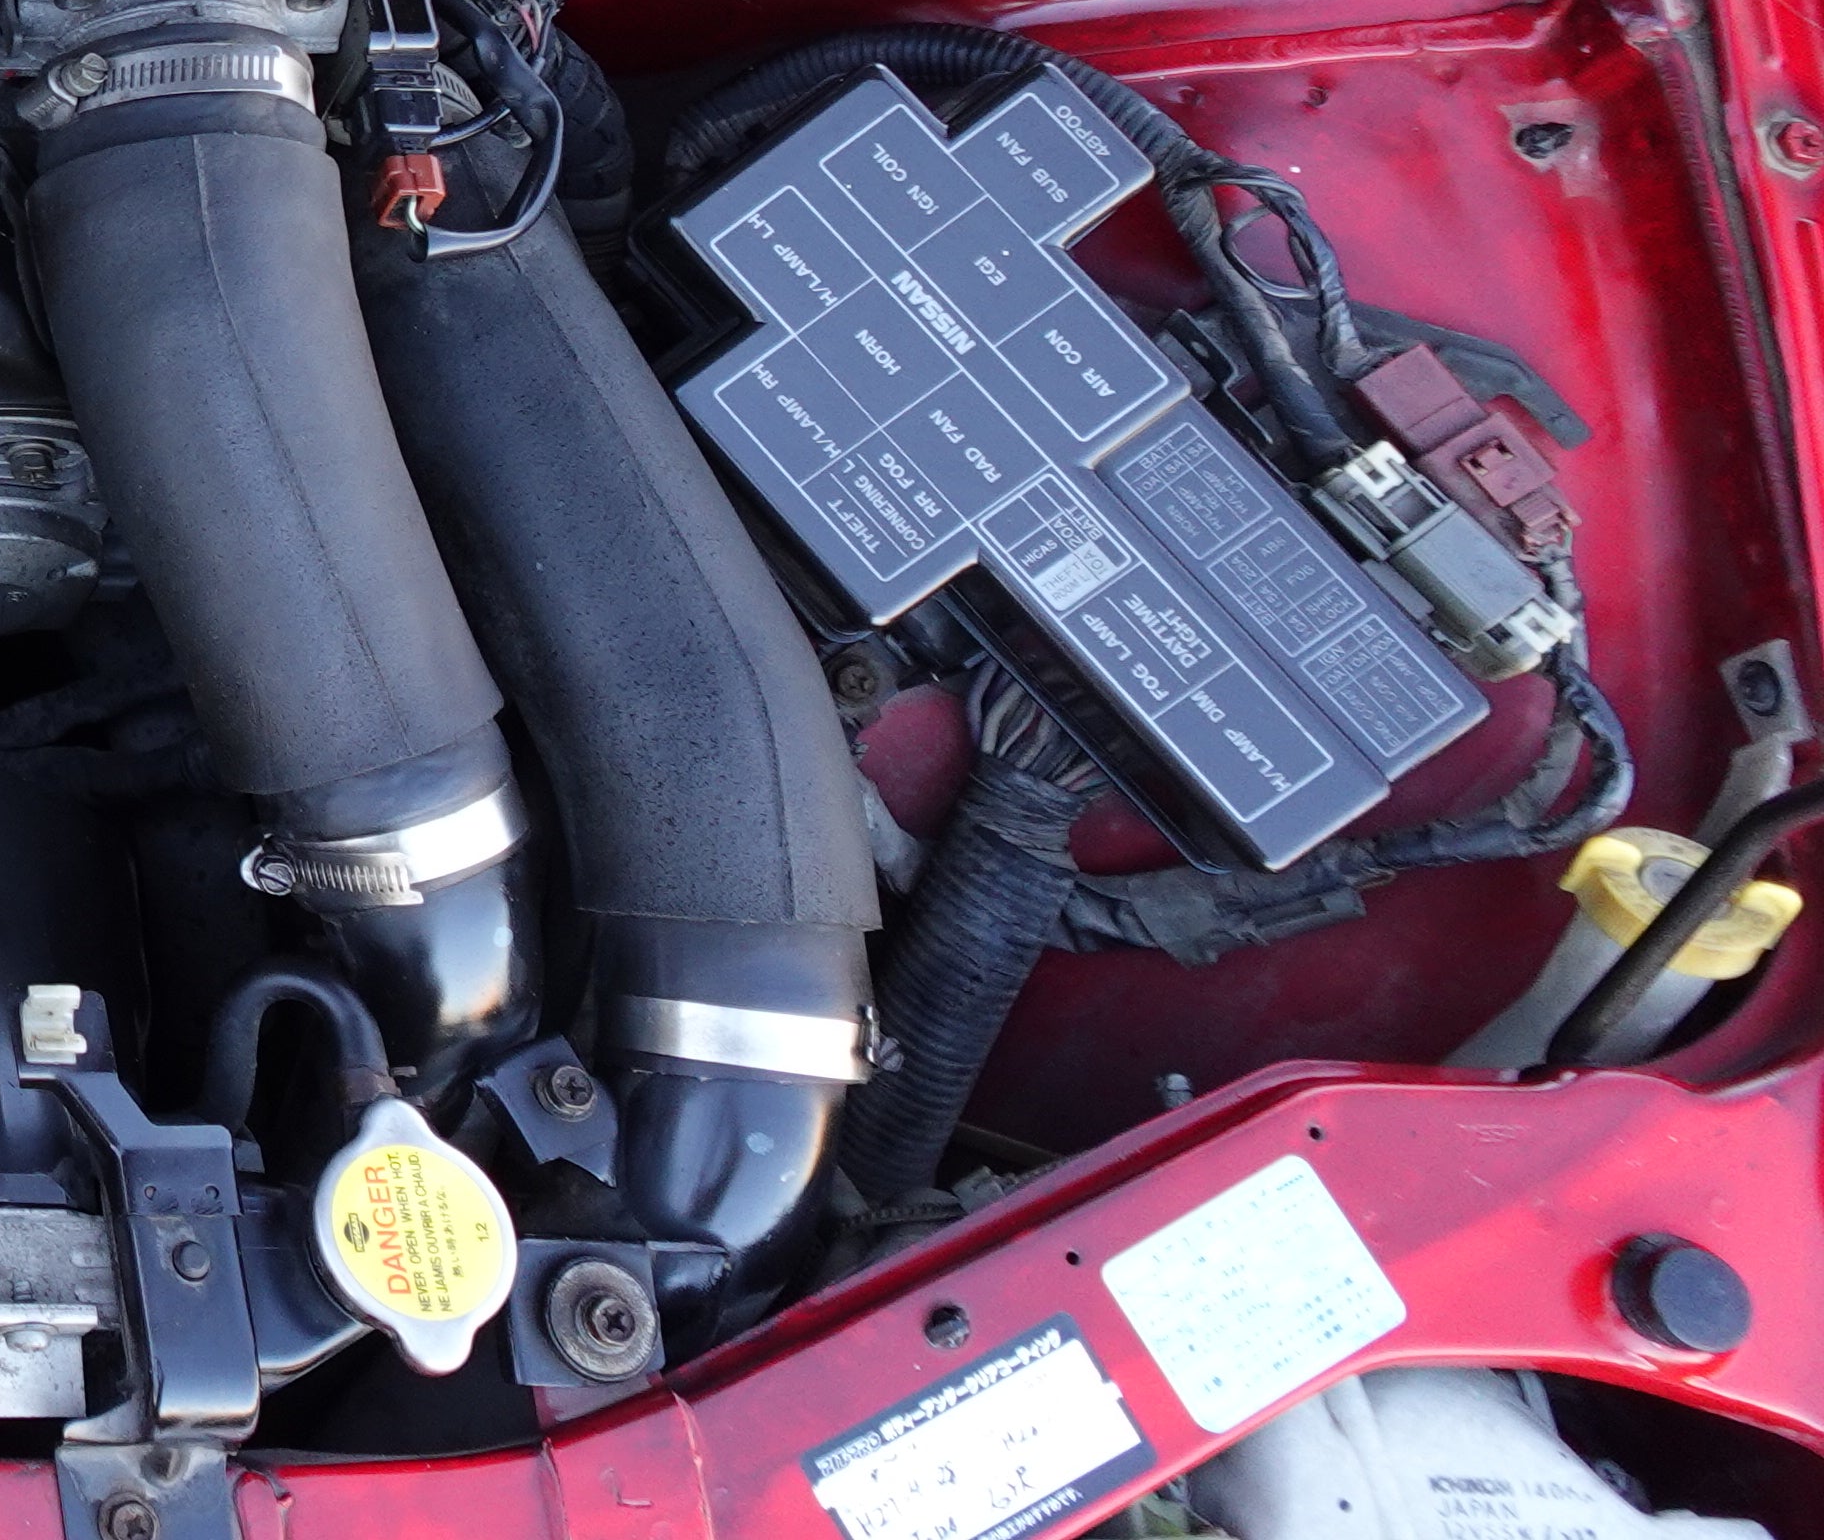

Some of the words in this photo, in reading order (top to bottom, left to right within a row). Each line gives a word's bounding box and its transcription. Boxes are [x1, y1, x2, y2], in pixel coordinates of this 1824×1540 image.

[995, 130, 1033, 167] FAN
[1054, 102, 1113, 160] 48P00
[866, 141, 909, 183] COIL
[906, 183, 940, 215] IGN
[1030, 166, 1070, 204] SUB
[745, 211, 776, 240] LH
[771, 239, 839, 307] H/LAMP
[972, 253, 1007, 286] EGI
[889, 268, 978, 356] NISSAN
[853, 327, 902, 376] HORN
[1043, 327, 1084, 366] CON
[749, 362, 780, 390] RH
[1080, 366, 1116, 400] AIR
[775, 390, 844, 458] H/LAMP
[927, 407, 966, 444] FAN
[837, 458, 856, 474] L
[876, 451, 916, 489] FOG
[963, 444, 1002, 483] RAD
[1138, 438, 1177, 469] BATT
[852, 474, 928, 550] CORNERING
[913, 490, 943, 518] RR
[1063, 501, 1103, 540] BATT
[825, 494, 884, 553] THEFT
[1051, 517, 1083, 547] 20A
[1019, 536, 1058, 568] HICAS
[1081, 548, 1109, 575] 10A
[1229, 554, 1257, 581] 20A
[1237, 588, 1276, 626] BATT
[1079, 608, 1133, 661] LAMP
[1122, 592, 1199, 669] DAYTIME
[1157, 604, 1213, 659] LIGHT
[1130, 662, 1169, 700] FOG
[1189, 688, 1226, 723] DIM
[1221, 722, 1293, 794] H/LAMP
[387, 1152, 404, 1179] HOT.
[407, 1152, 427, 1196] CHAUD.
[395, 1186, 412, 1222] WHEN
[417, 1198, 429, 1206] A
[363, 1165, 412, 1296] DANGER
[404, 1230, 422, 1264] OPEN
[419, 1210, 439, 1253] OUVRIR
[474, 1222, 490, 1241] 1.2
[413, 1271, 433, 1312] NEVER
[430, 1256, 448, 1293] JAMIS
[438, 1295, 452, 1312] NE
